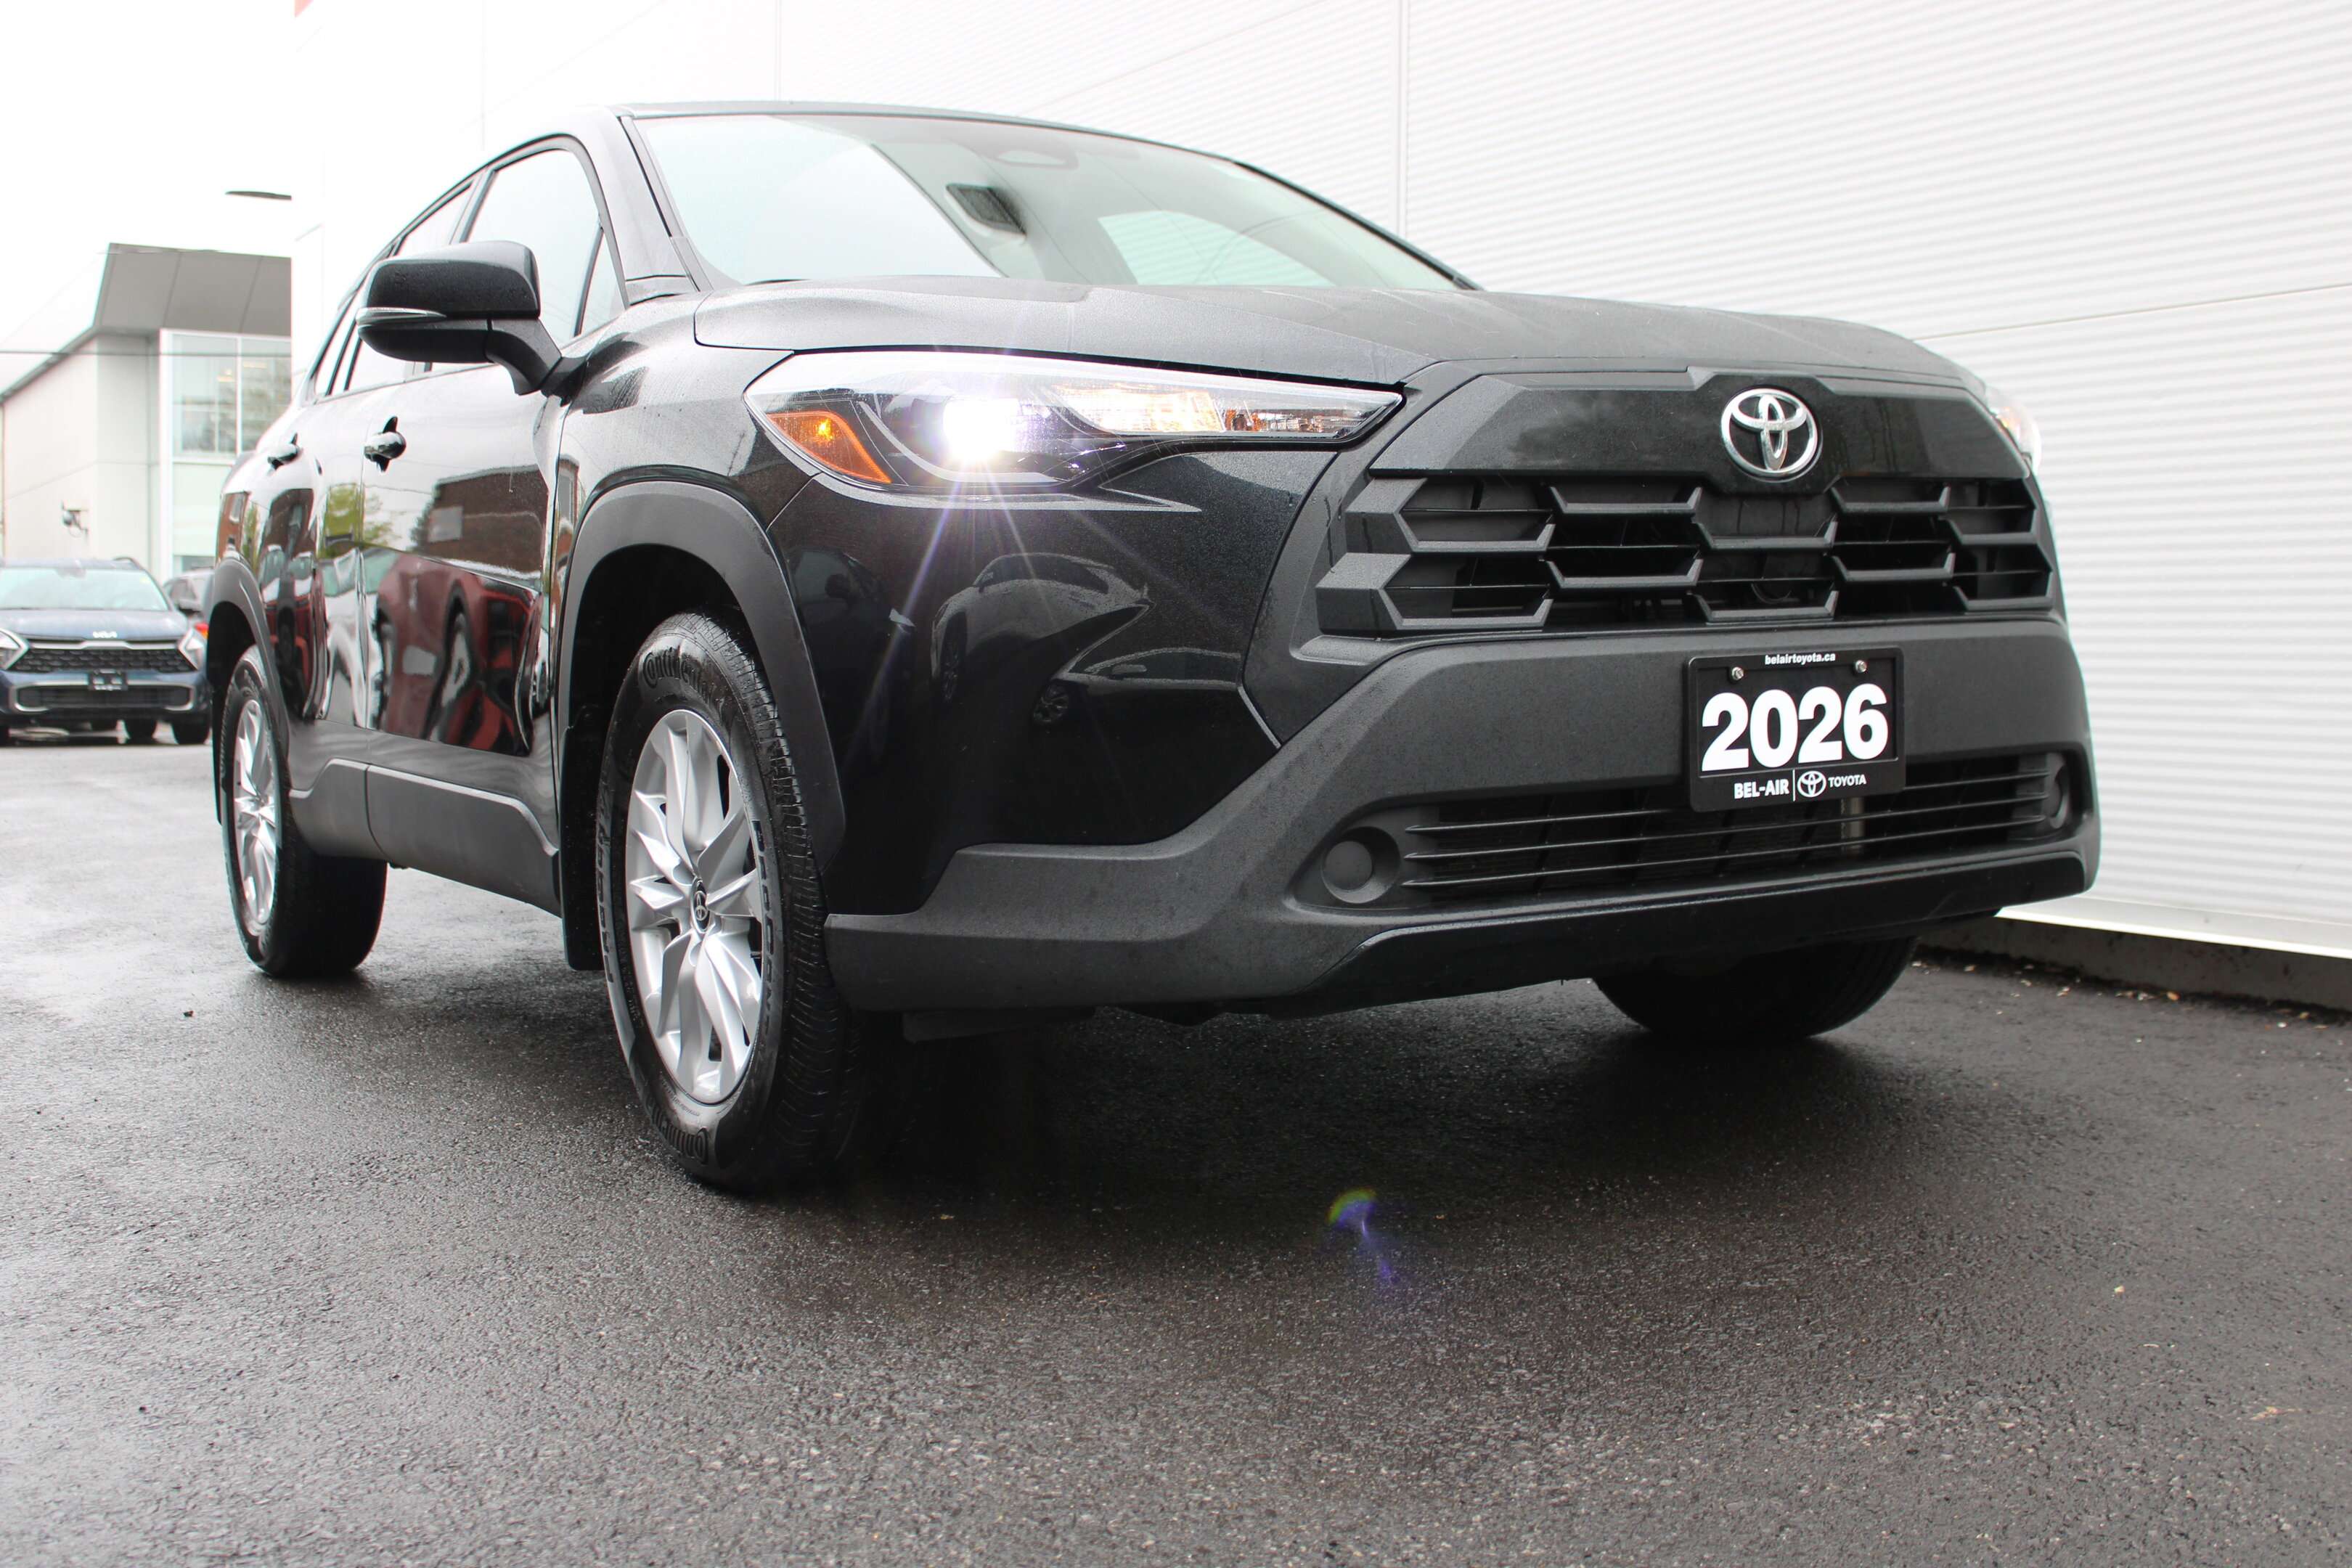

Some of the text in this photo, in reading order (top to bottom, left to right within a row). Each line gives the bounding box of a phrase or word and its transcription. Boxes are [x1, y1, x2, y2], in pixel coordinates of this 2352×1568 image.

[1765, 653, 1836, 665] belairtoyota.ca
[1702, 683, 1889, 772] 2026
[1734, 774, 1867, 799] BEL-AIR TOYOTA
